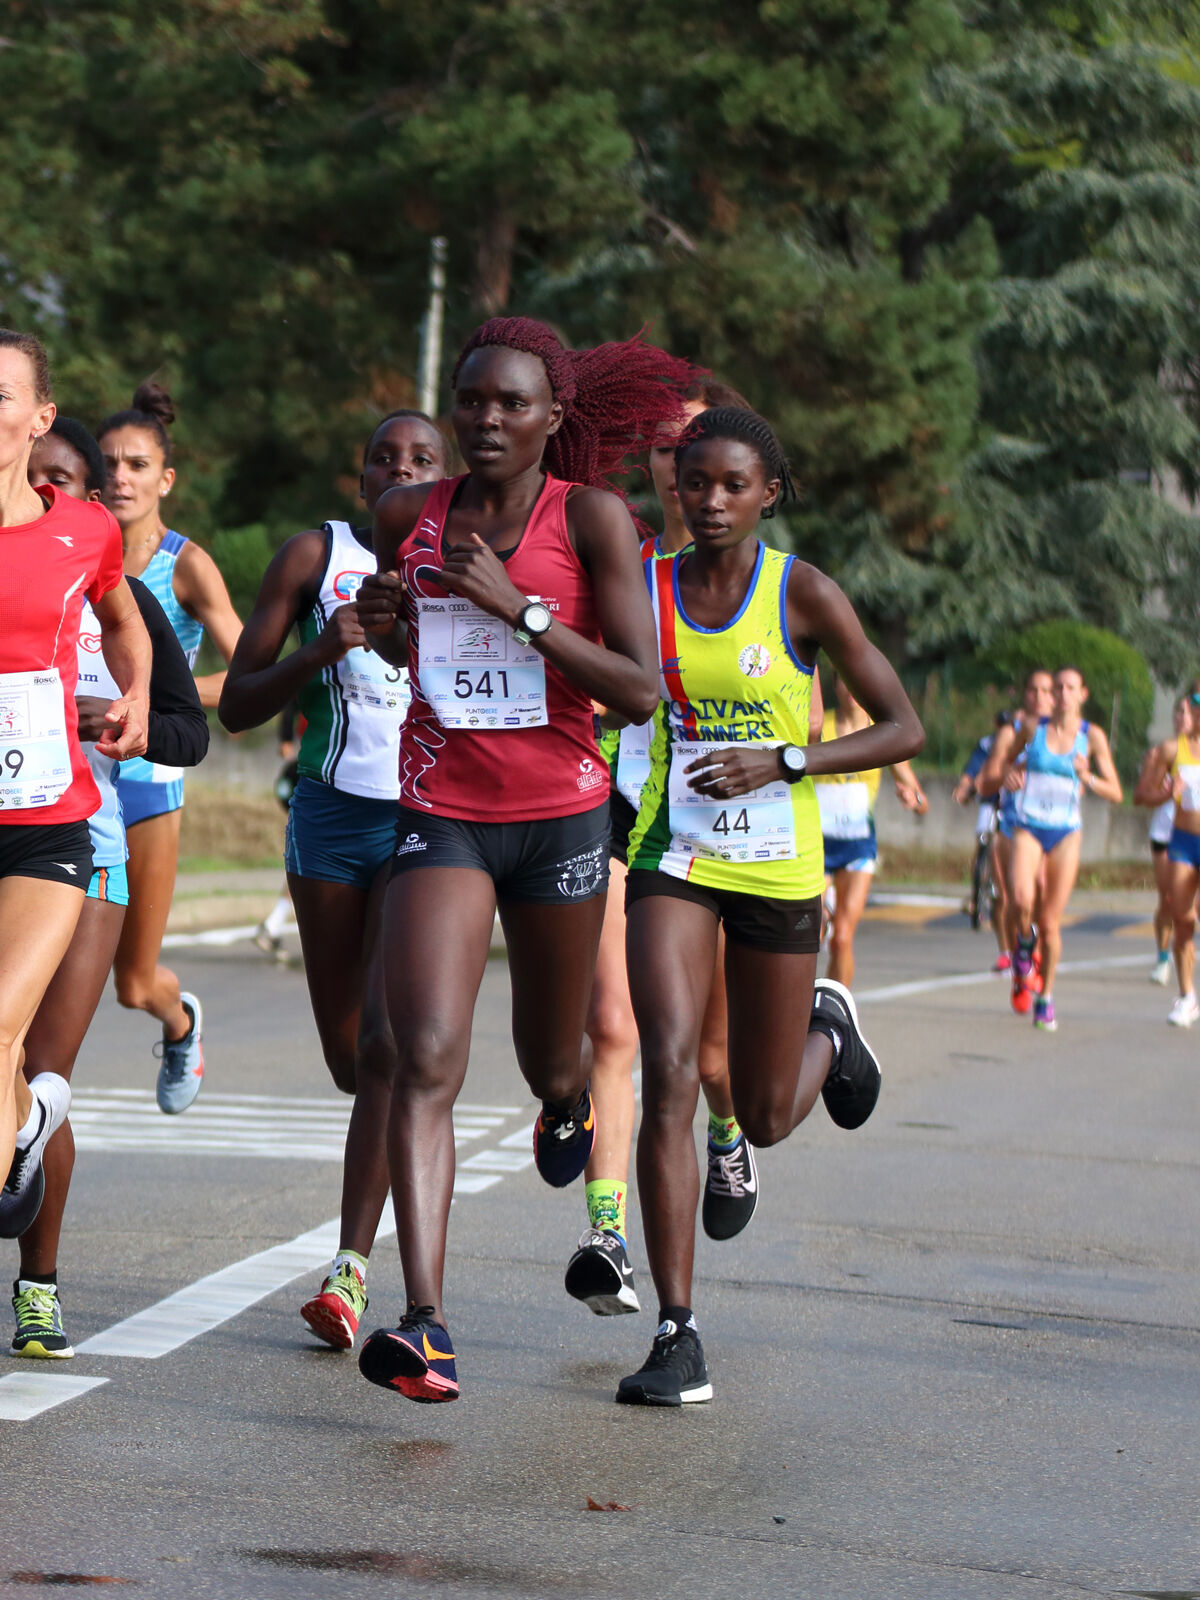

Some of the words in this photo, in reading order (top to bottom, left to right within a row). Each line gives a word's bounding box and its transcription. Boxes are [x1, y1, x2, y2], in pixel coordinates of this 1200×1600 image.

[453, 670, 509, 699] 541
[669, 699, 773, 720] CAIVANO
[675, 720, 775, 742] RUNNERS
[712, 808, 751, 836] 44
